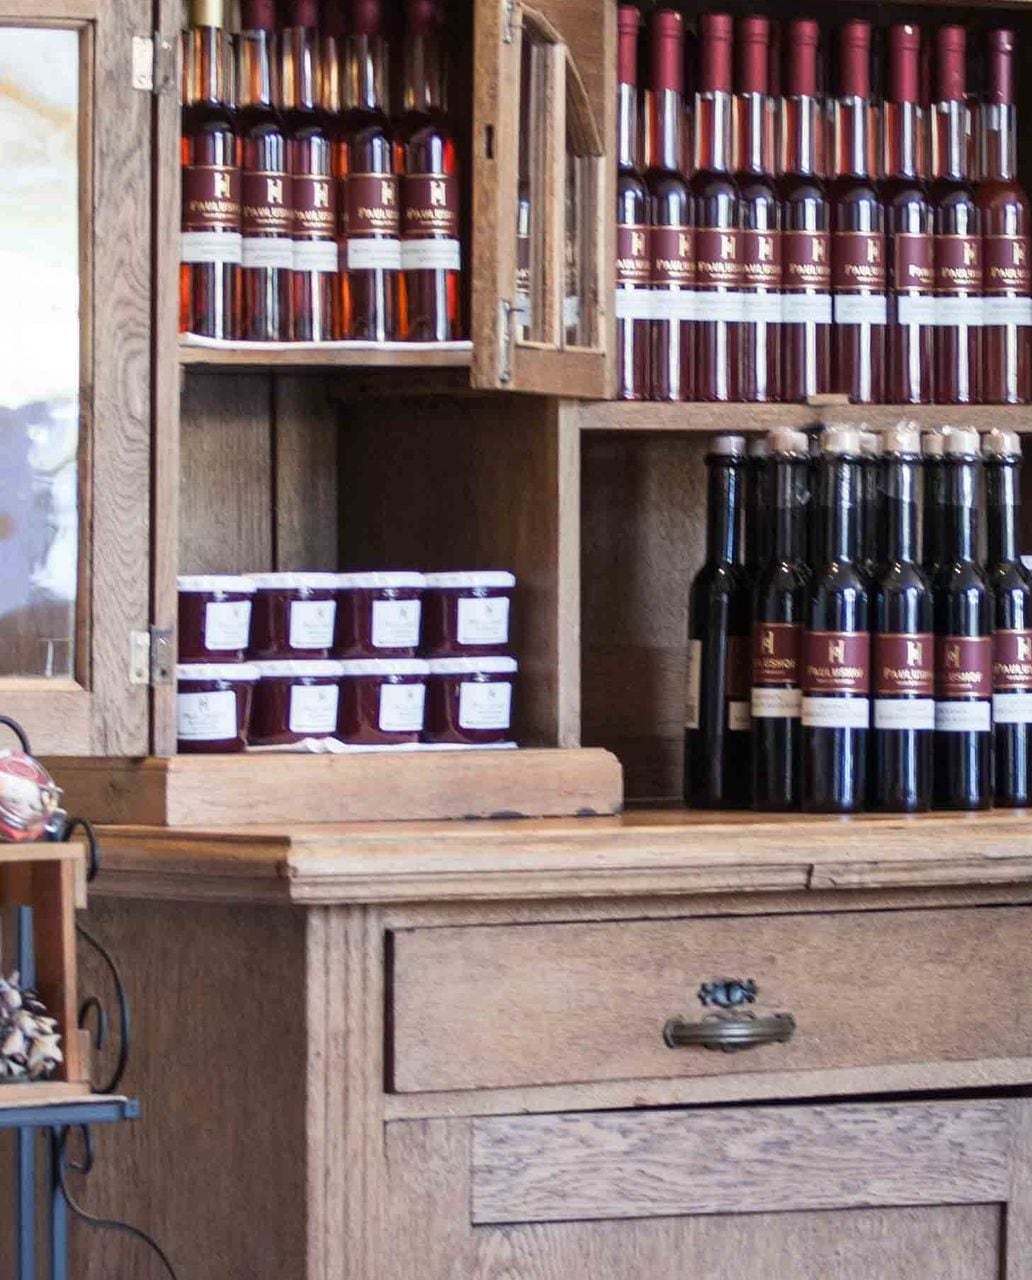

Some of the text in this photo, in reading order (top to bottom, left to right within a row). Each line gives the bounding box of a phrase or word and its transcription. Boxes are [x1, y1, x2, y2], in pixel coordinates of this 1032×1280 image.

[213, 172, 231, 199] H
[267, 177, 283, 204] H
[313, 182, 329, 208] H
[381, 180, 395, 206] H
[430, 180, 446, 207] H
[631, 231, 645, 256] H
[721, 234, 736, 260] H
[758, 235, 774, 261] H
[812, 237, 826, 262] H
[828, 639, 845, 664] H
[907, 640, 922, 666] H
[1017, 636, 1032, 661] H
